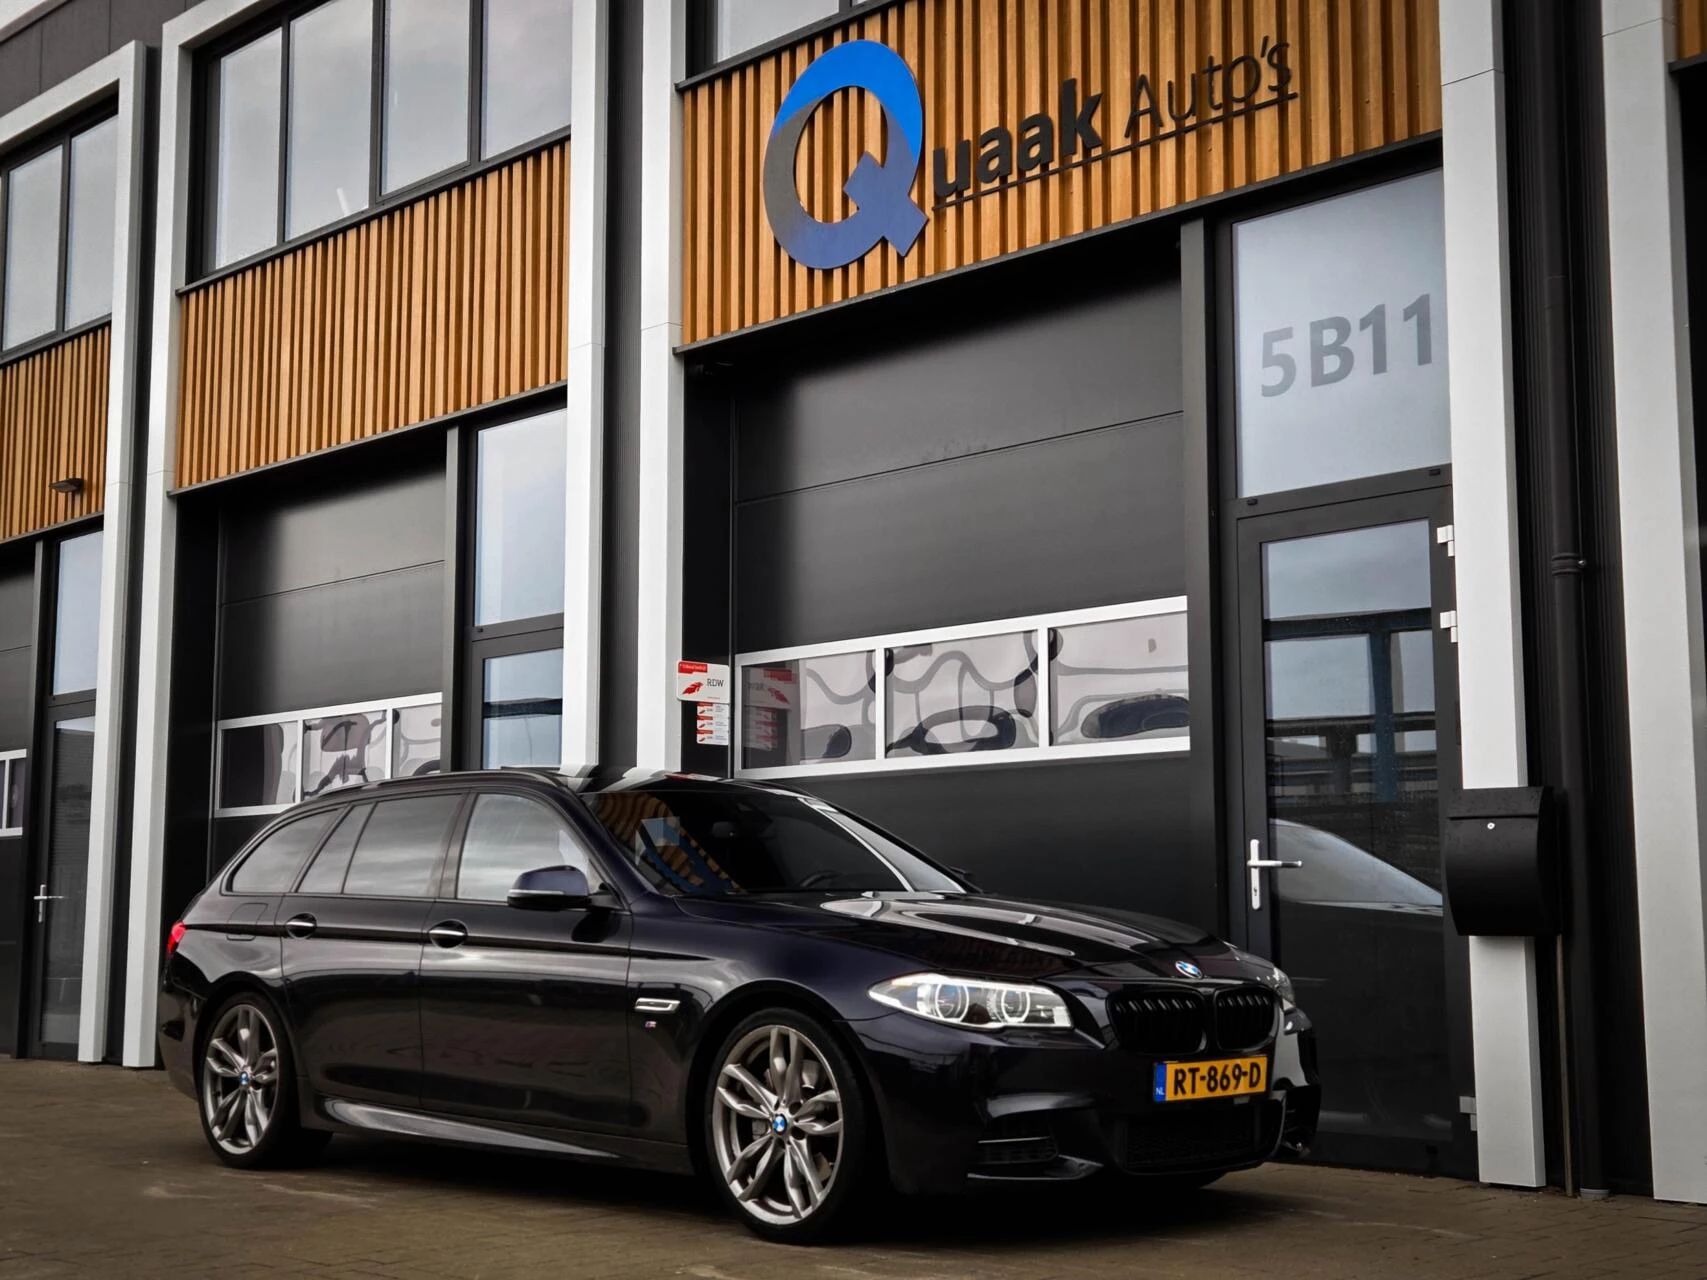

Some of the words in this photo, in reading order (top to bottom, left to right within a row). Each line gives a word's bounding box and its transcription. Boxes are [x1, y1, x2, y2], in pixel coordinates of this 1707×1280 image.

[1124, 36, 1291, 138] Auto's
[1260, 293, 1433, 398] 5B11
[706, 678, 724, 688] RDW
[1155, 1087, 1165, 1096] NL
[1173, 1061, 1261, 1096] RT-869-D
